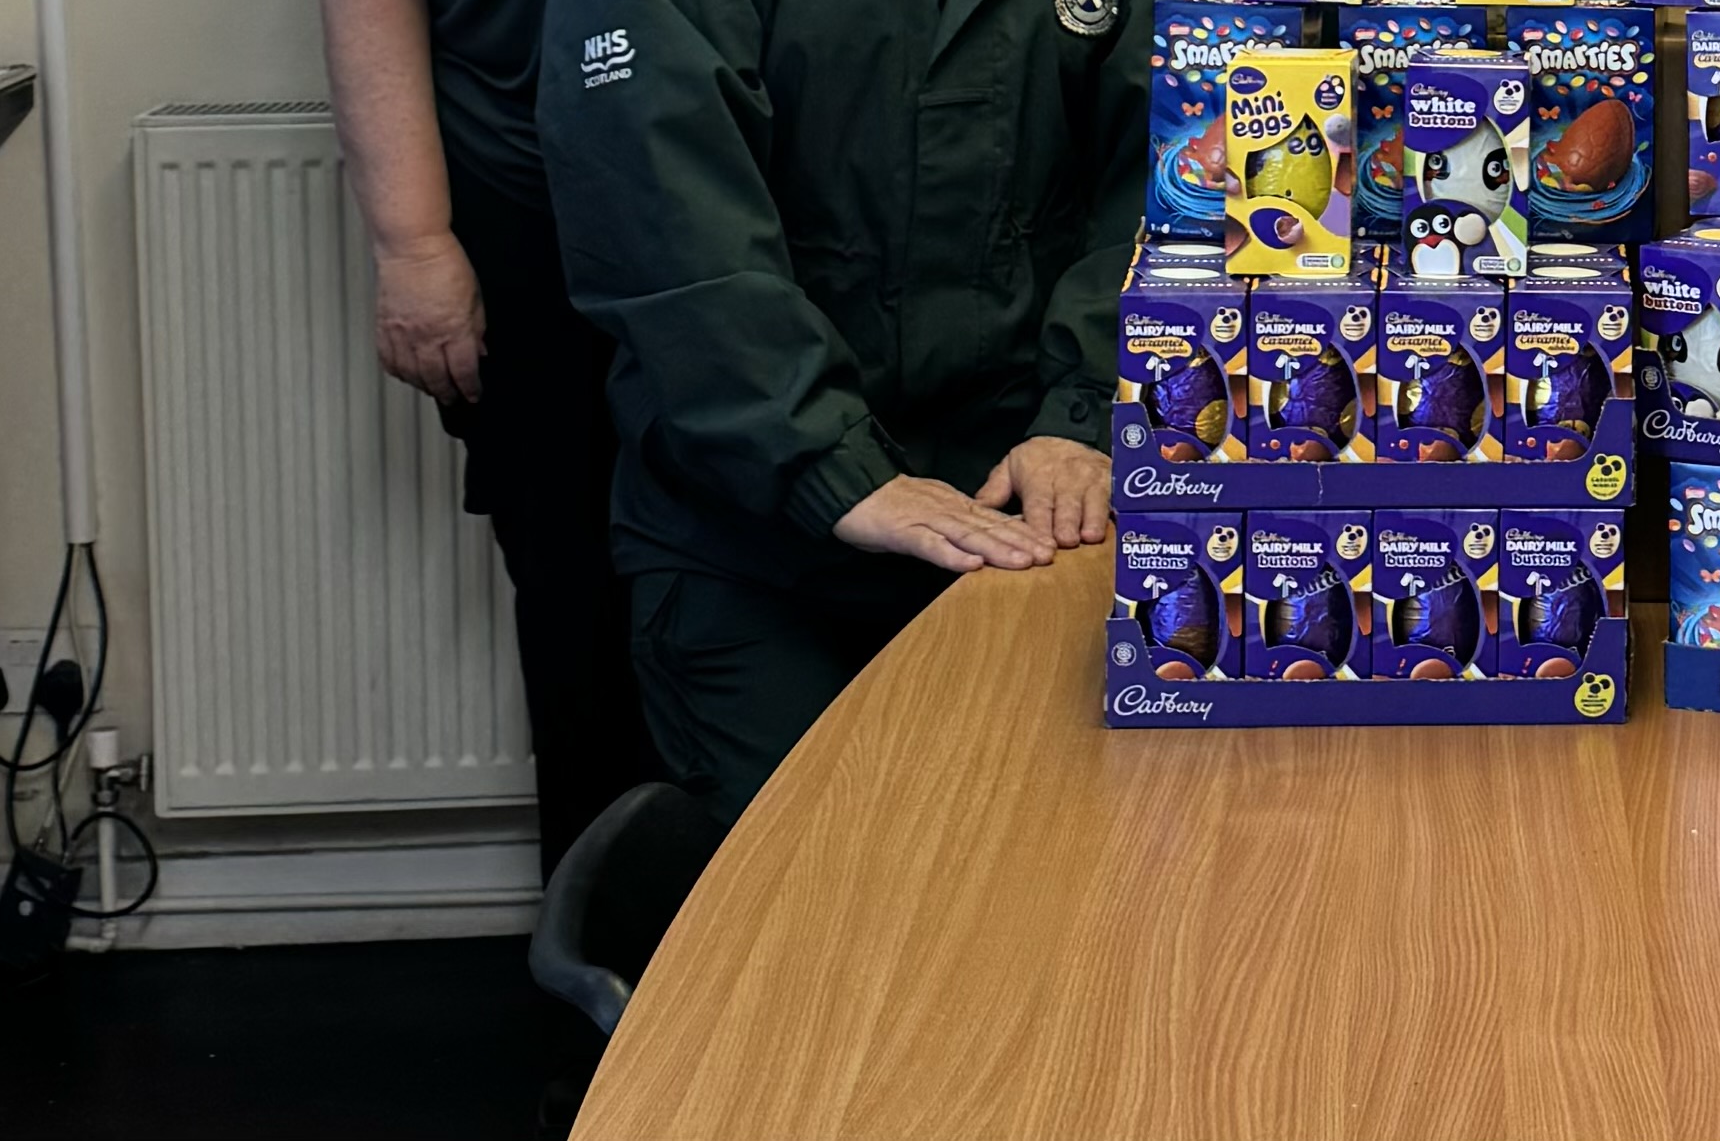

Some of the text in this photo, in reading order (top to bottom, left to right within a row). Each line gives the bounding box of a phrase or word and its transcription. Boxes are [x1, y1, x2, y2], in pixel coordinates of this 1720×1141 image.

[584, 29, 629, 61] NHS
[1231, 90, 1284, 119] Mini
[1410, 98, 1476, 113] white
[1232, 113, 1292, 138] eggs
[1410, 114, 1476, 128] buttons
[1644, 280, 1702, 299] white
[1643, 294, 1702, 315] buttons
[1126, 325, 1197, 336] DAIRY MILK
[1256, 323, 1326, 335] DAIRY MILK
[1386, 323, 1456, 335] DAIRY MILK
[1514, 322, 1584, 334] DAIRY MILK
[1123, 466, 1224, 503] Cadbury
[1122, 543, 1194, 555] DAIRY MILK
[1252, 542, 1324, 554] DAIRY MILK
[1380, 541, 1451, 553] DAIRY MILK
[1506, 540, 1577, 552] DAIRY MILK
[1129, 555, 1188, 569] buttons
[1258, 555, 1318, 568] buttons
[1385, 553, 1445, 567] buttons
[1512, 553, 1571, 566] buttons
[1113, 684, 1214, 721] Cadbury
